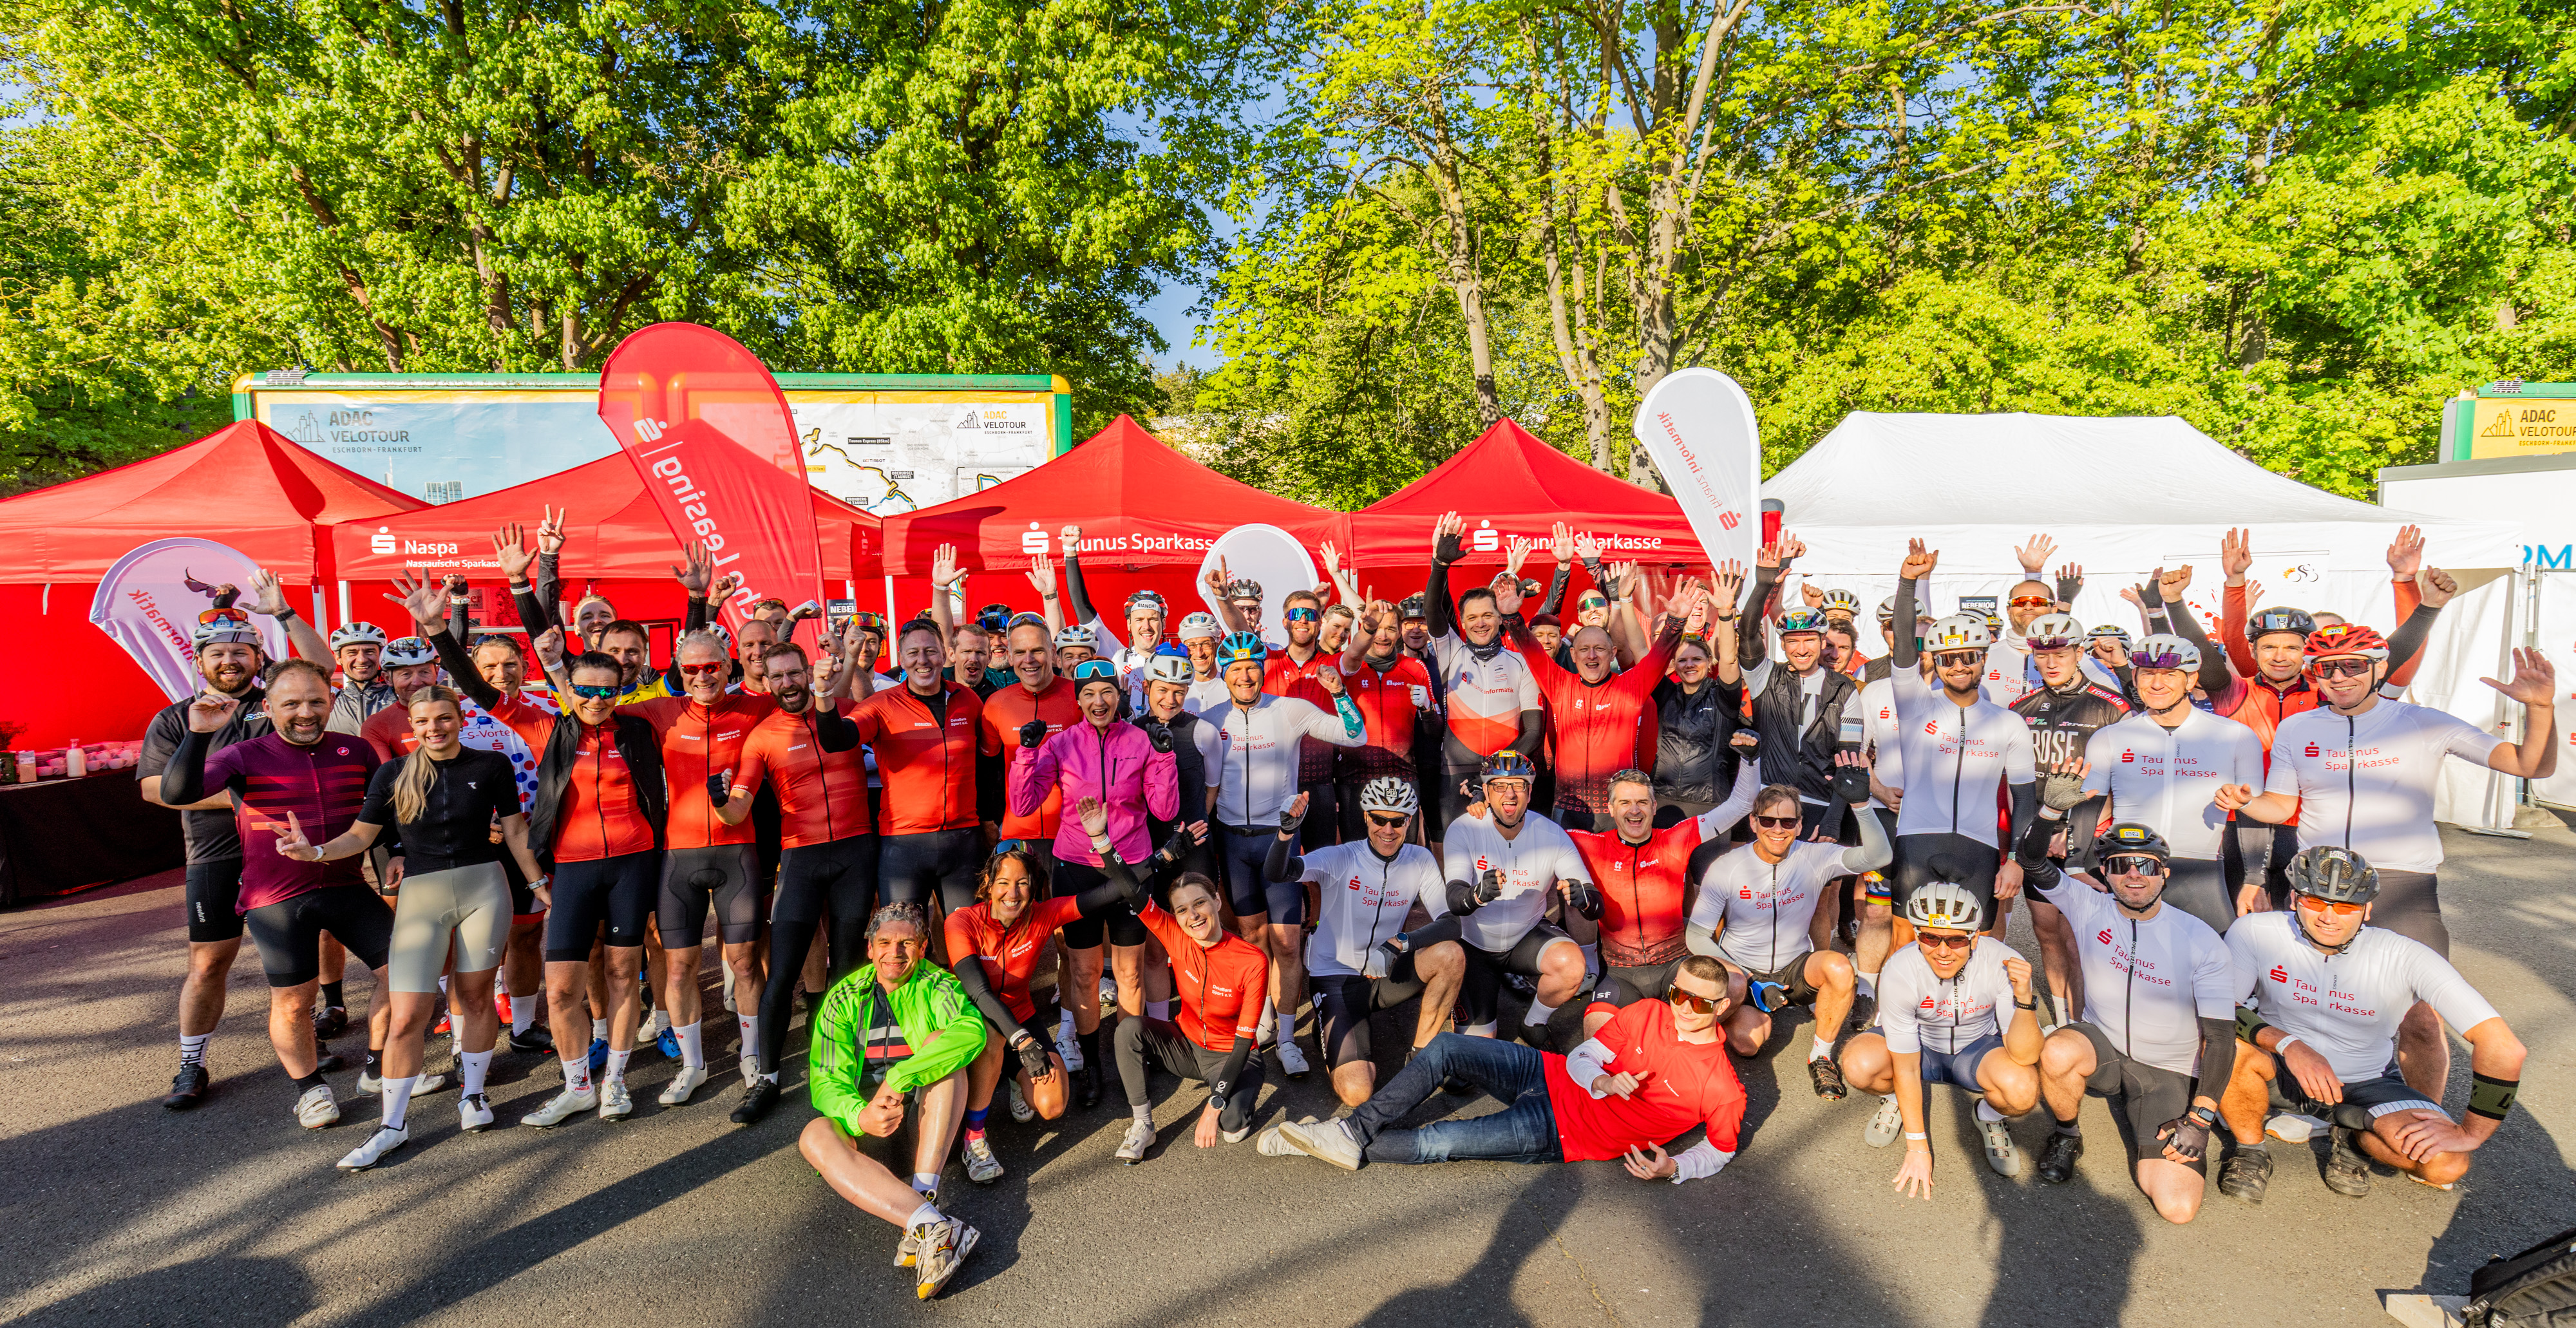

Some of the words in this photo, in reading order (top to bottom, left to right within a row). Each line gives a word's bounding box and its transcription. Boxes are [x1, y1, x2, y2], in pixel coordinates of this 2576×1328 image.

[330, 411, 373, 426] ADAC
[983, 411, 1007, 419] ADAC
[2520, 410, 2556, 422] ADAC
[330, 430, 410, 442] VELOTOUR
[404, 540, 458, 556] Naspa
[1132, 533, 1213, 553] Sparkass
[461, 560, 501, 569] Sparkass
[2091, 688, 2124, 706] rose.de
[717, 729, 741, 737] DekaBank
[2031, 730, 2079, 766] ROSE
[2260, 844, 2270, 875] RYZON
[196, 902, 205, 923] newline
